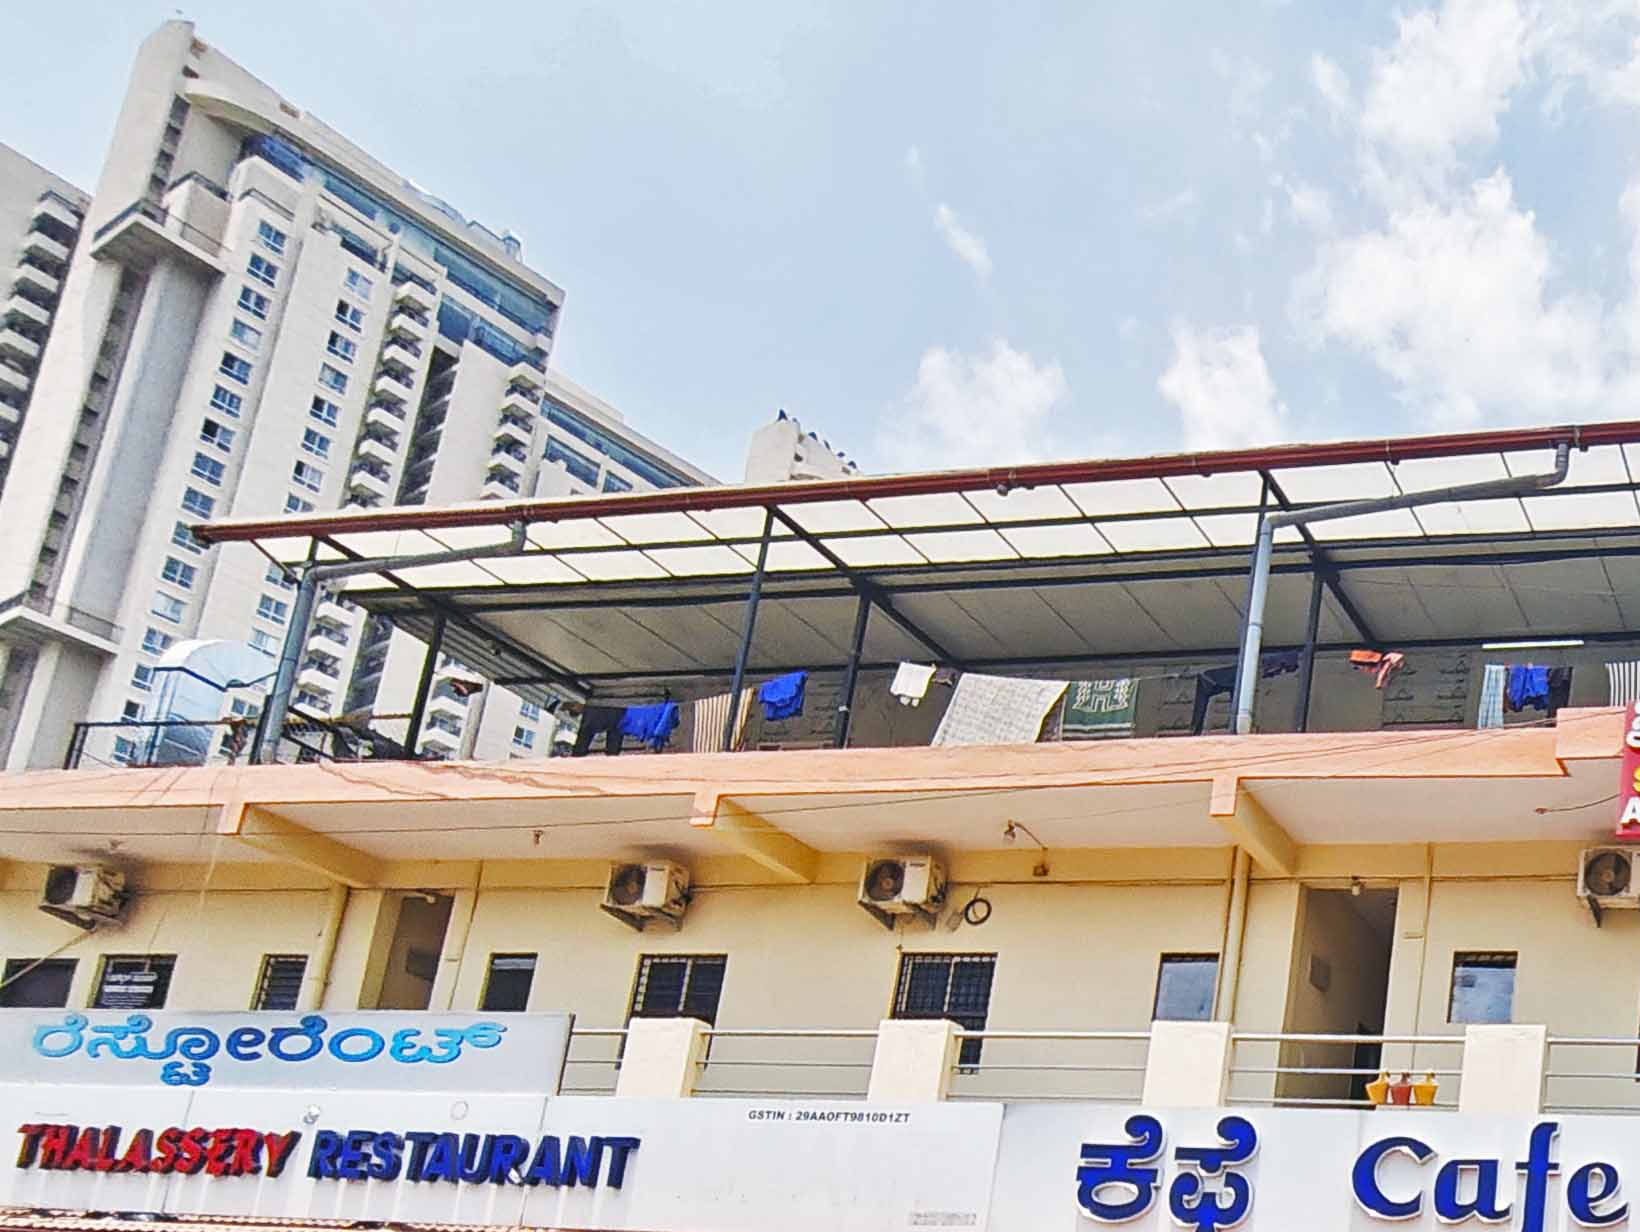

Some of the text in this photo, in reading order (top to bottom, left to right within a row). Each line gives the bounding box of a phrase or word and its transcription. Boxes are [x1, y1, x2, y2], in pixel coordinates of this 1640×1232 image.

[33, 1014, 507, 1086] ರೆಸ್ಟೋರೆಂಟ್
[748, 1110, 785, 1120] GSTIN
[15, 1122, 642, 1190] THALASSERY RESTAURANT
